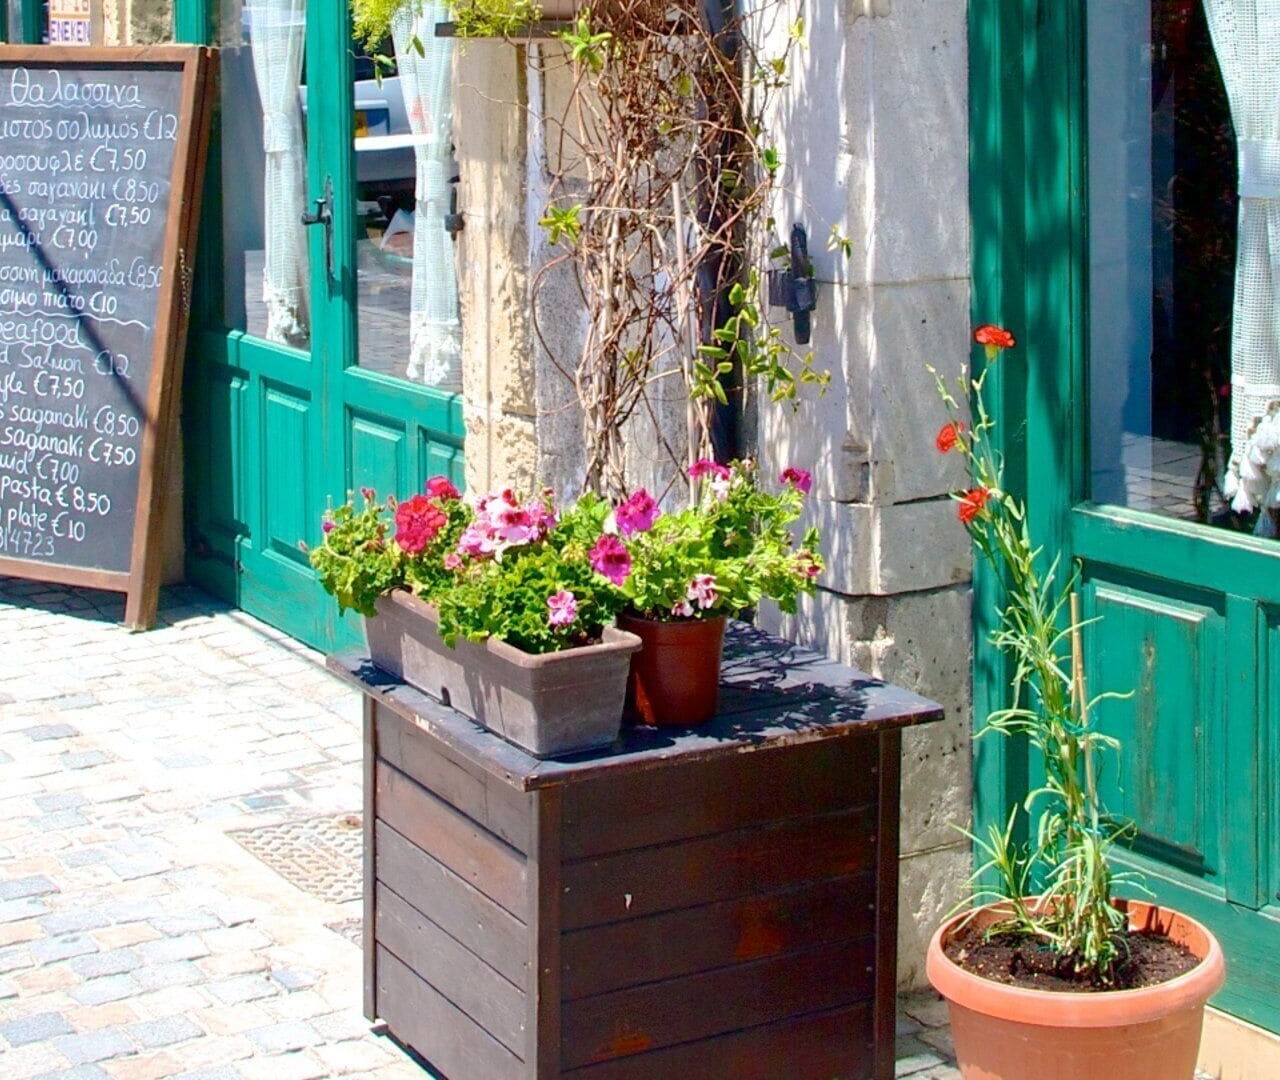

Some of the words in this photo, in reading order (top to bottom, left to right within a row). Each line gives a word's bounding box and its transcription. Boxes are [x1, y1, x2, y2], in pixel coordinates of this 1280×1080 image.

[142, 109, 179, 142] €12
[88, 145, 148, 173] €7,50
[111, 176, 159, 205] €8,50
[104, 203, 151, 227] €7,50
[89, 290, 118, 315] €10
[92, 349, 132, 379] €12
[33, 369, 85, 400] €7,50
[8, 403, 89, 434] saganaki
[93, 405, 140, 437] €8,50
[0, 425, 84, 463] saganaki
[87, 436, 137, 467] €7,50
[35, 452, 80, 485] €7,00
[0, 475, 54, 507] pasta
[7, 501, 49, 535] plate
